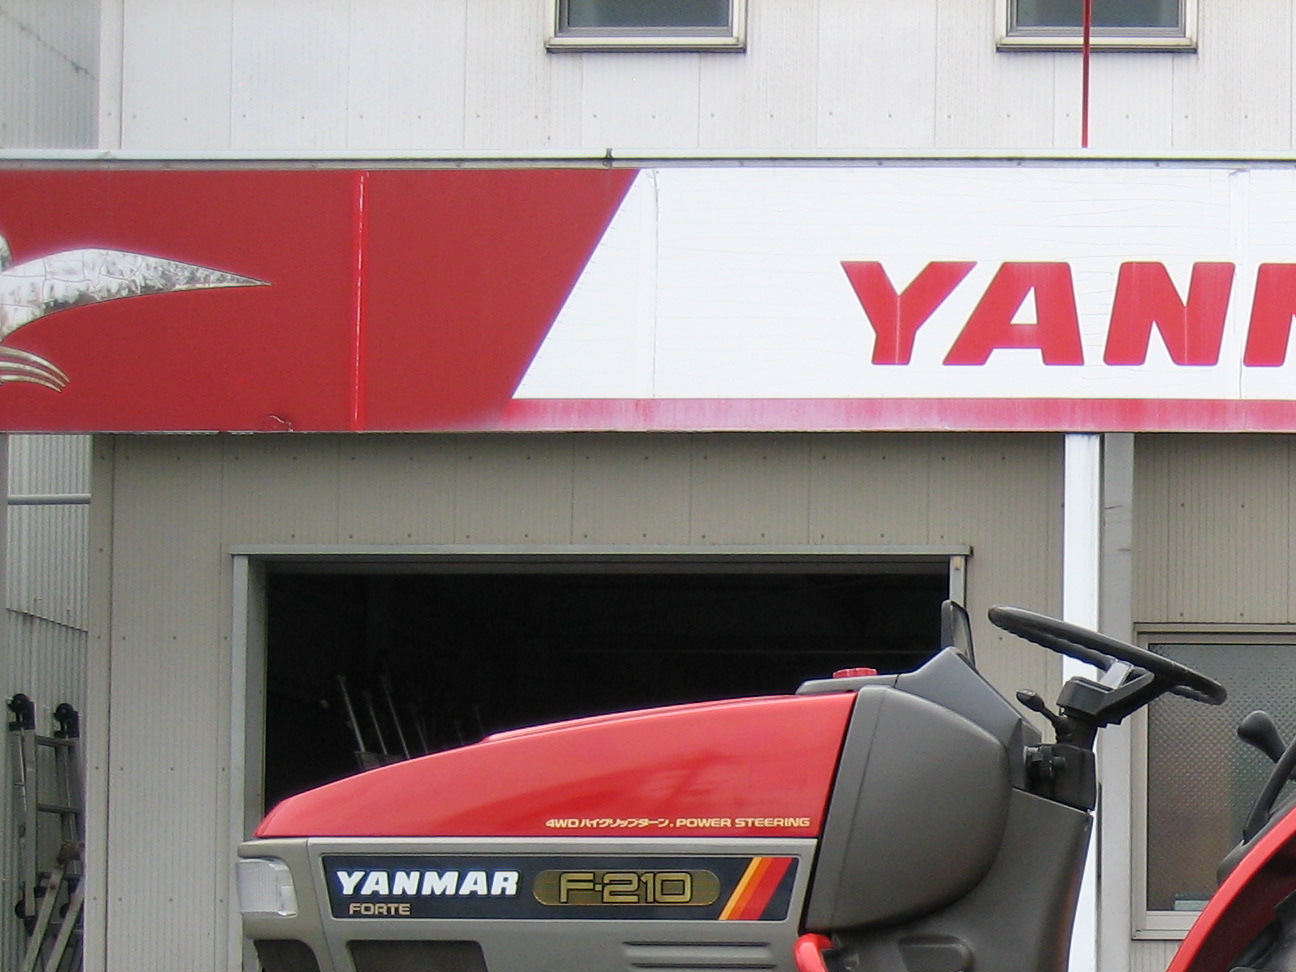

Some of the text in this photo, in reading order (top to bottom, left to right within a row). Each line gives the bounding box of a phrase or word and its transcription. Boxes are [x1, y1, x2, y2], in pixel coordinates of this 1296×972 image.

[676, 818, 731, 828] POWER
[735, 818, 811, 828] STEERING
[336, 870, 520, 896] YANMAR
[559, 871, 693, 904] F-210
[349, 903, 411, 916] FORTE
